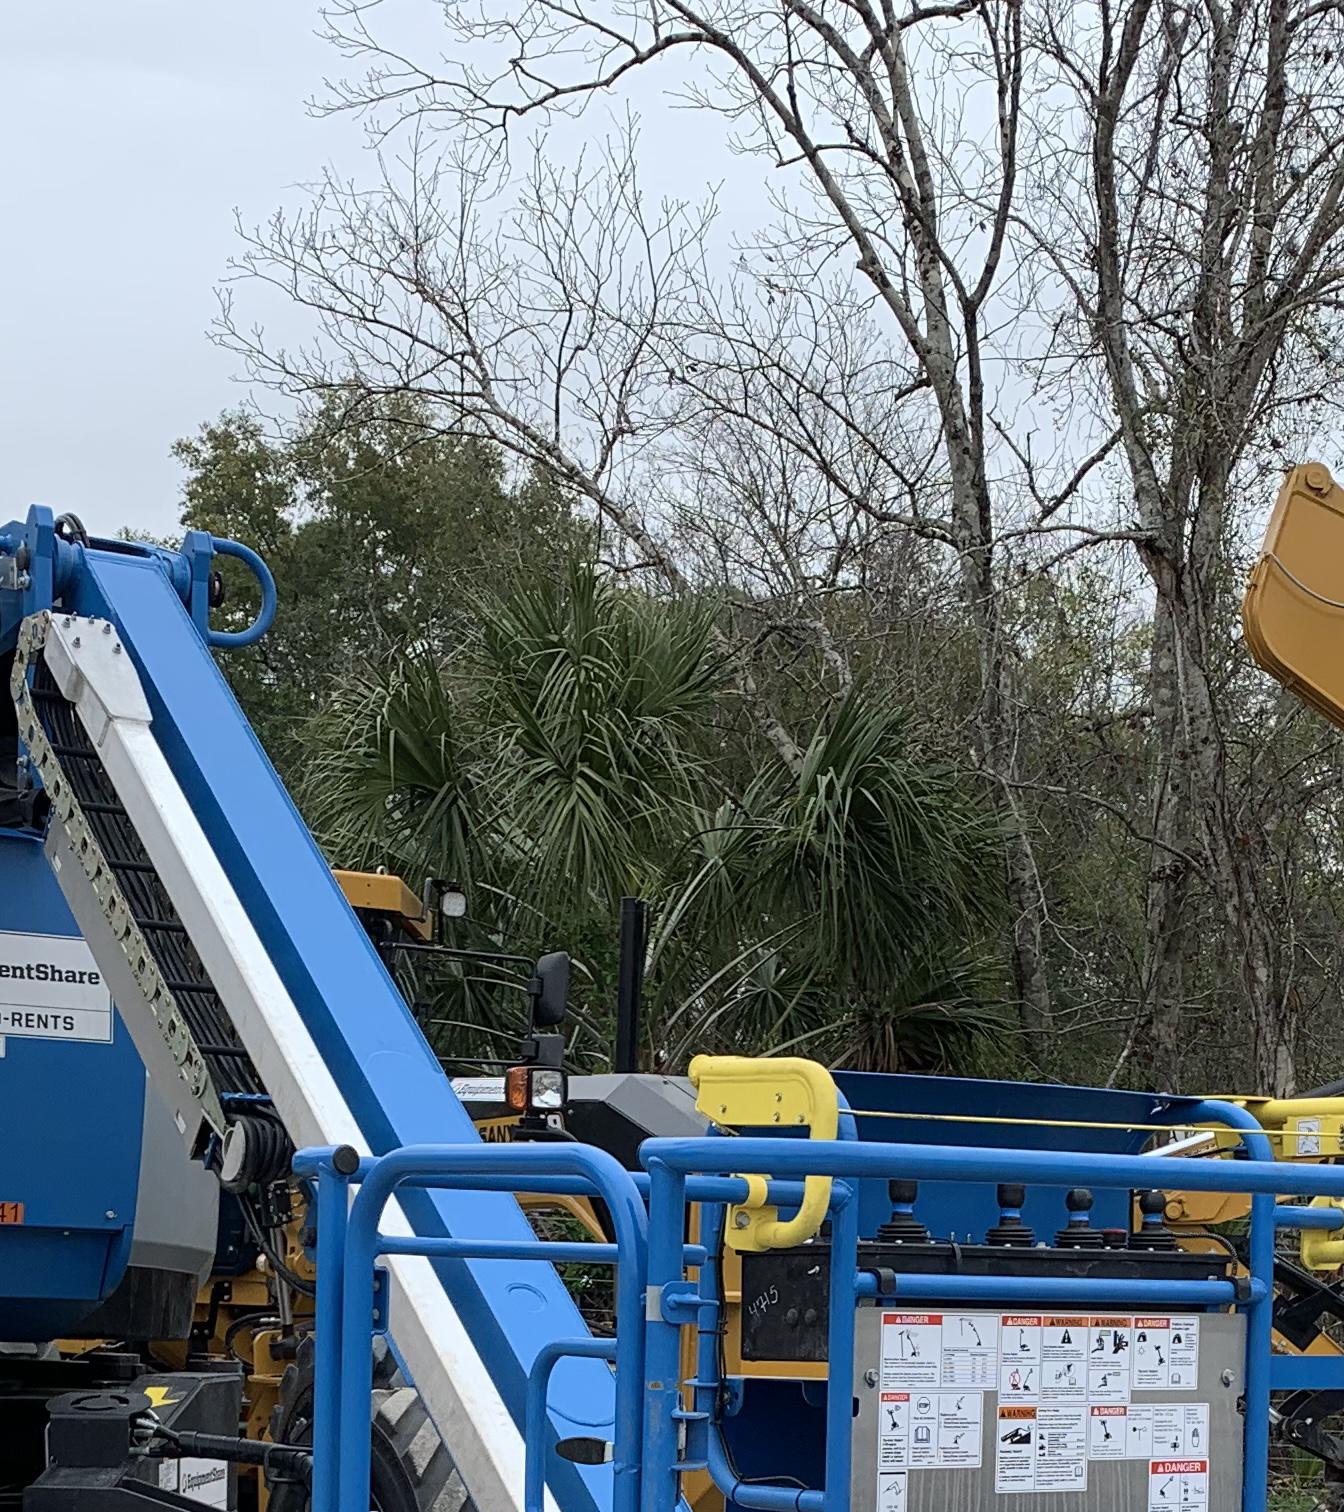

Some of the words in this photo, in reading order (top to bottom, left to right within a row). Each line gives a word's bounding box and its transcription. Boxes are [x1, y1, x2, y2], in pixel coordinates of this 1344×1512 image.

[748, 1285, 779, 1317] 4715
[902, 1315, 929, 1324] DANGER
[1012, 1317, 1038, 1326] DANGER
[1056, 1318, 1083, 1327] WARNING
[1143, 1319, 1168, 1328] DANGER
[1007, 1408, 1036, 1418] WARNING
[1099, 1407, 1125, 1416] DANGER
[1164, 1462, 1201, 1473] DANGER
